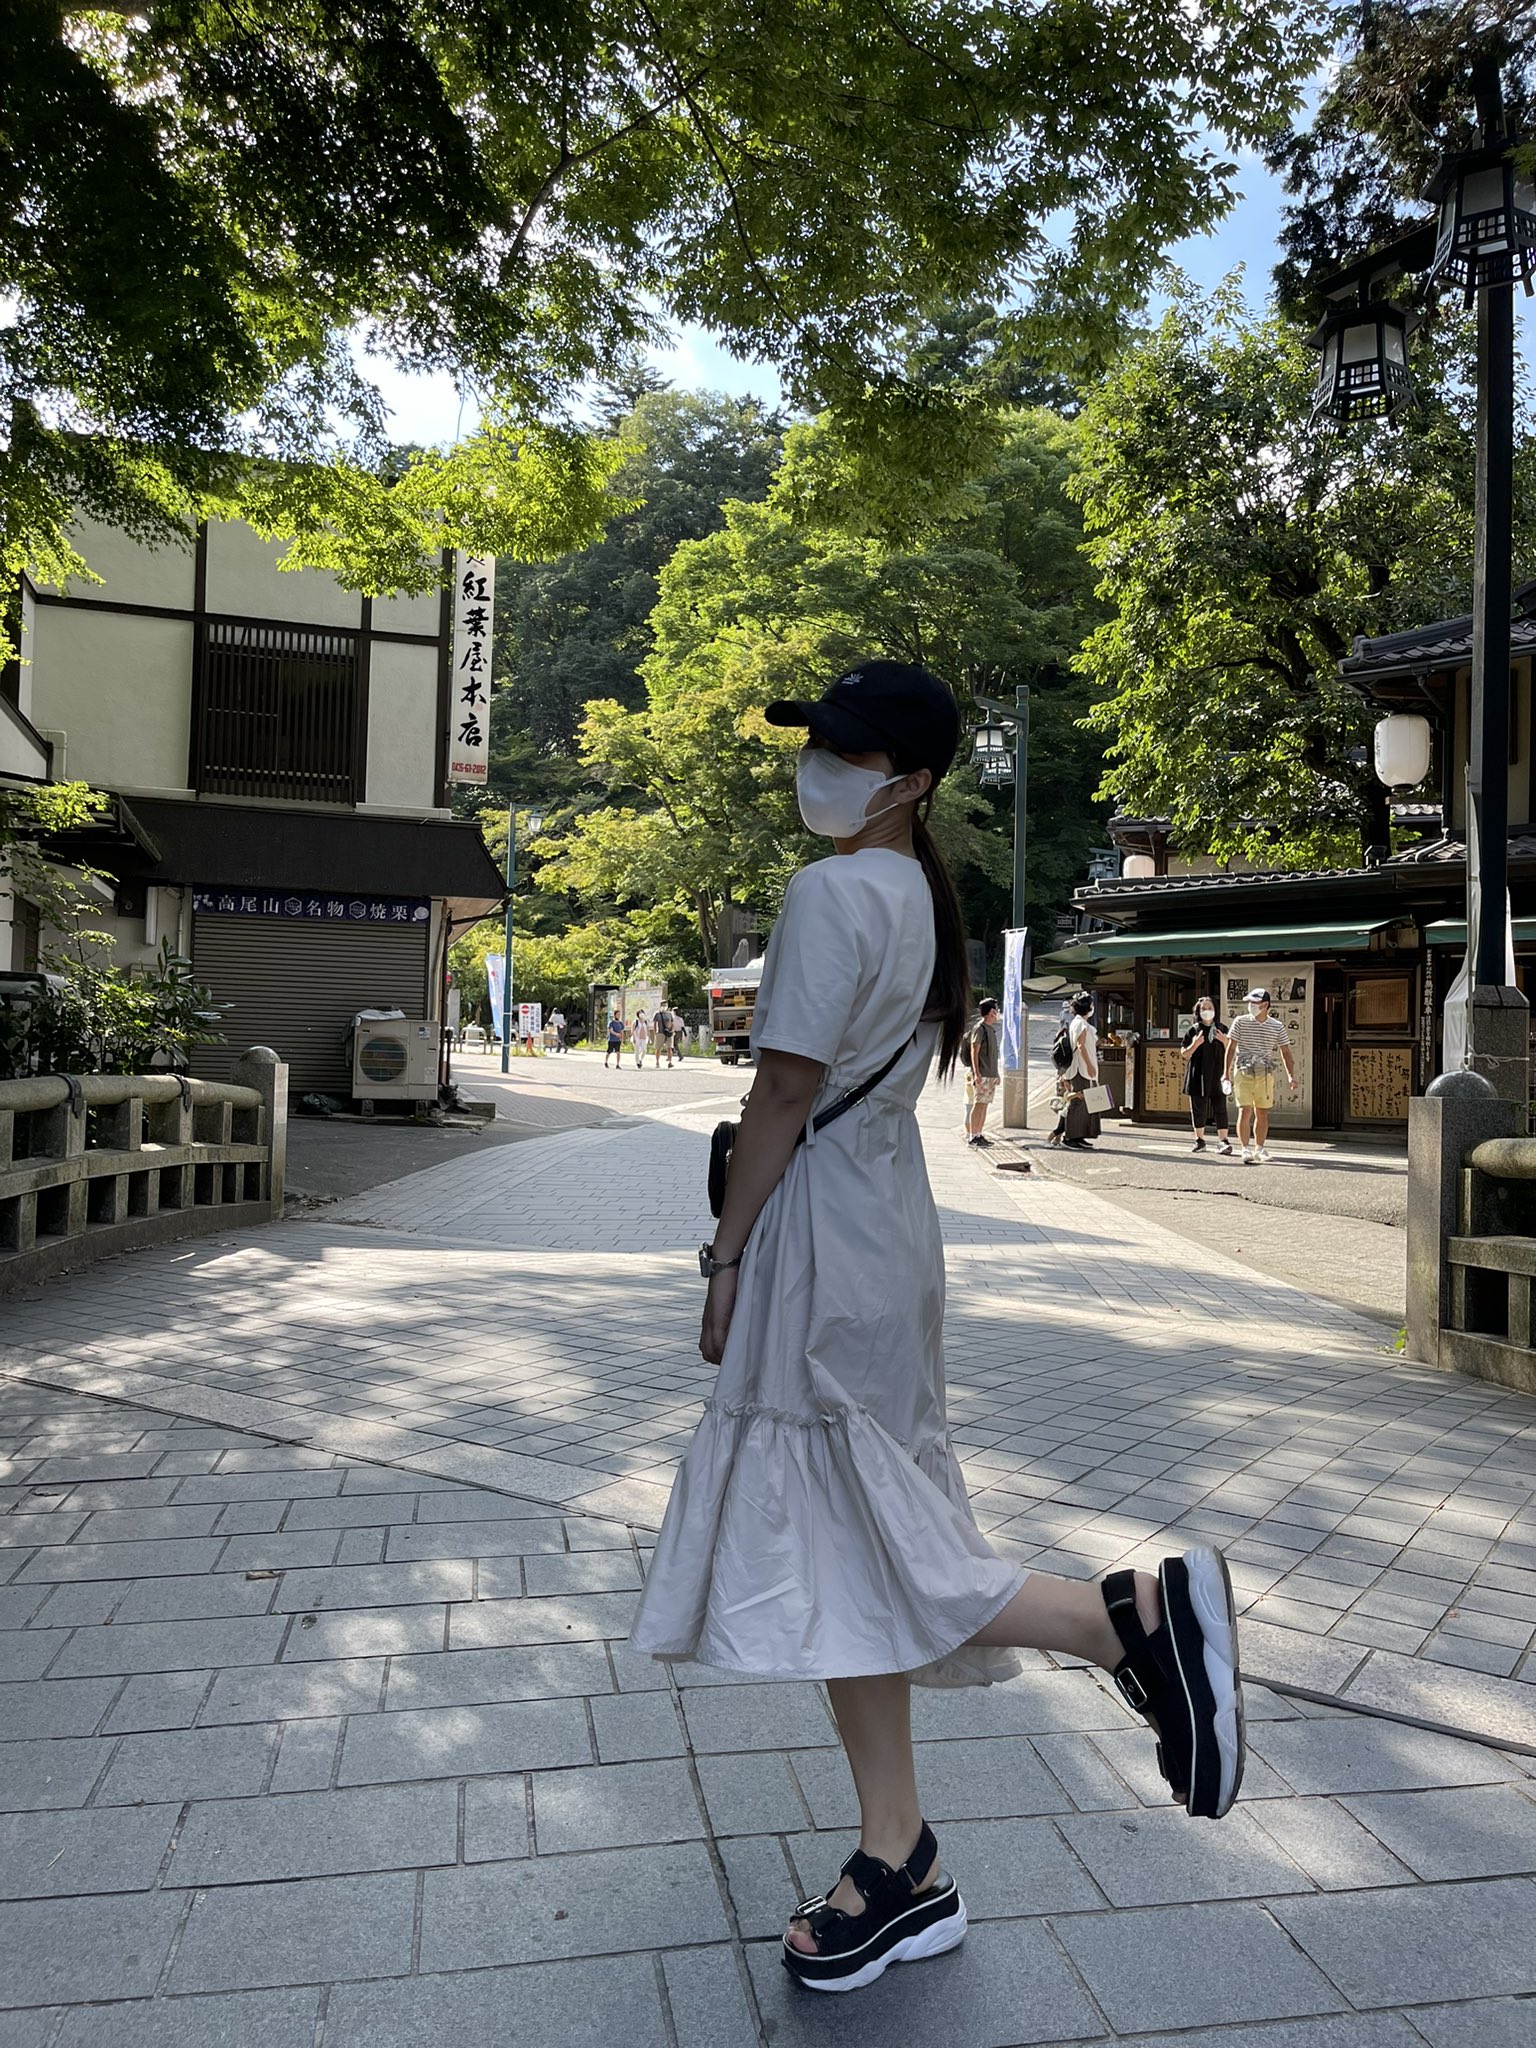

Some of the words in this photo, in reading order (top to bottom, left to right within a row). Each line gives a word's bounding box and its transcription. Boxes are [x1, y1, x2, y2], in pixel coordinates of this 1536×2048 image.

[458, 571, 491, 747] 紅葉屋本店
[218, 894, 279, 914] 高尾山
[306, 900, 344, 918] 名物
[369, 904, 408, 921] 焼栗
